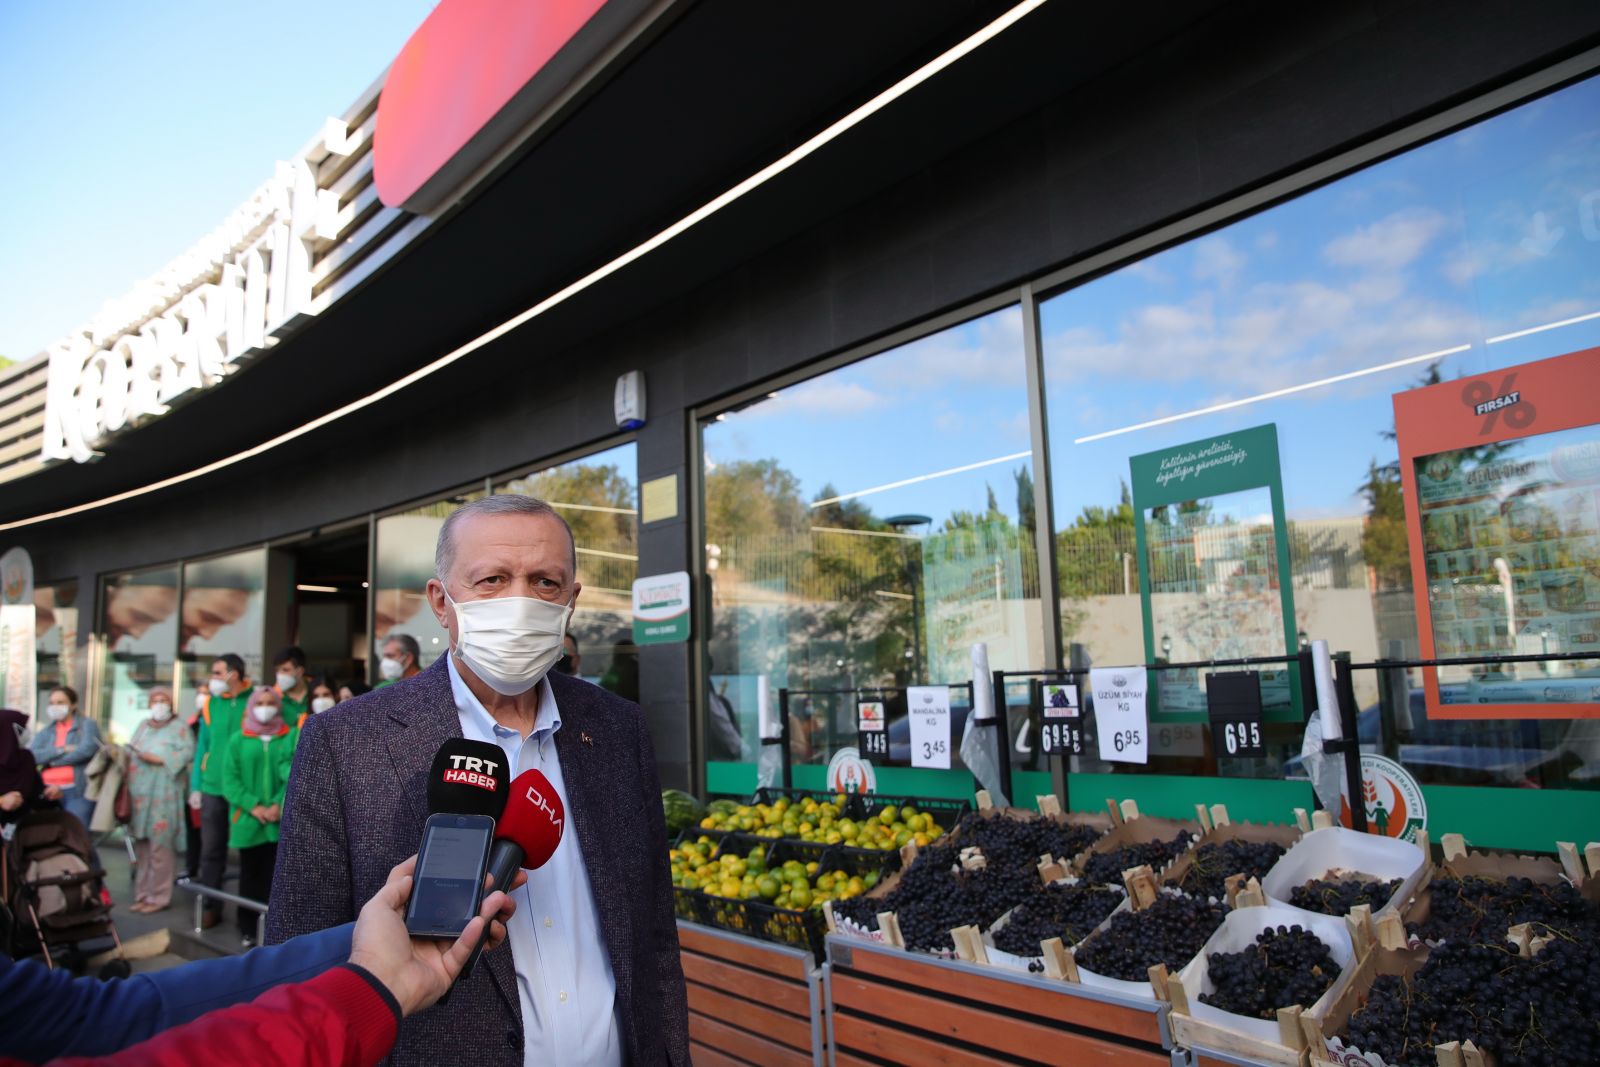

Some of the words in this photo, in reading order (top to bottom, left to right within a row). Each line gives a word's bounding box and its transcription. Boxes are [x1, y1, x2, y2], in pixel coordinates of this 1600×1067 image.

[1476, 392, 1519, 415] FIRSAT
[1098, 690, 1120, 700] ÜZÜM
[1117, 702, 1130, 712] KG
[449, 755, 499, 776] TRT
[446, 770, 497, 790] HABER
